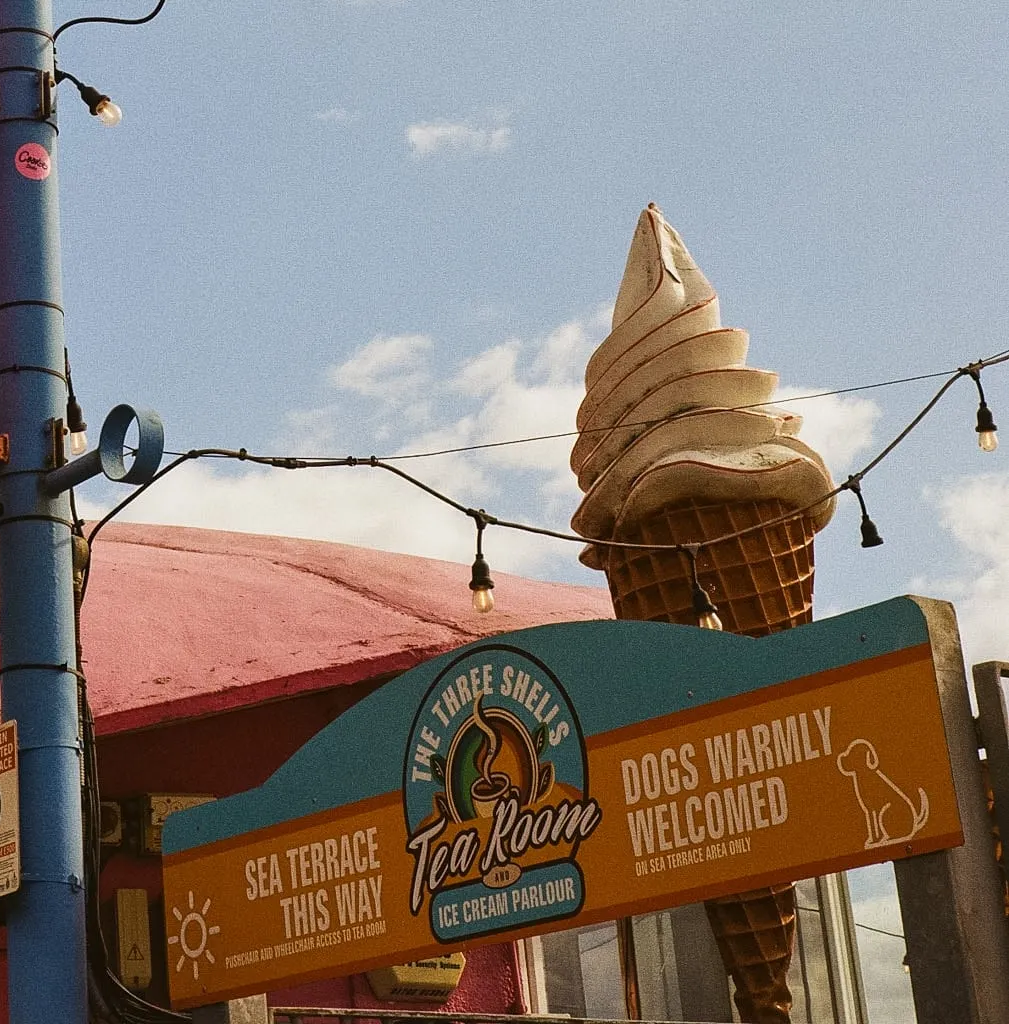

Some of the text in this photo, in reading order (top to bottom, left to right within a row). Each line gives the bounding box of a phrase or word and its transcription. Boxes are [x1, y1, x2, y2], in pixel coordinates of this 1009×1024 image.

[412, 725, 441, 783] THE
[431, 664, 494, 727] THREE
[620, 706, 833, 805] DOGS WARMLY
[627, 776, 789, 857] WELCOMED
[245, 826, 381, 901] SEA TERRACE
[408, 798, 601, 913] Tea Room
[494, 870, 510, 883] AND
[635, 836, 752, 877] ON SEA TERRACE AREA ONLY
[279, 875, 383, 939] THIS WAY
[438, 877, 576, 928] ICE CREAM PARLOUR
[224, 920, 387, 969] PUSHCHAIR AND WHEELCHAIR ACCESS TO TEA ROOM
